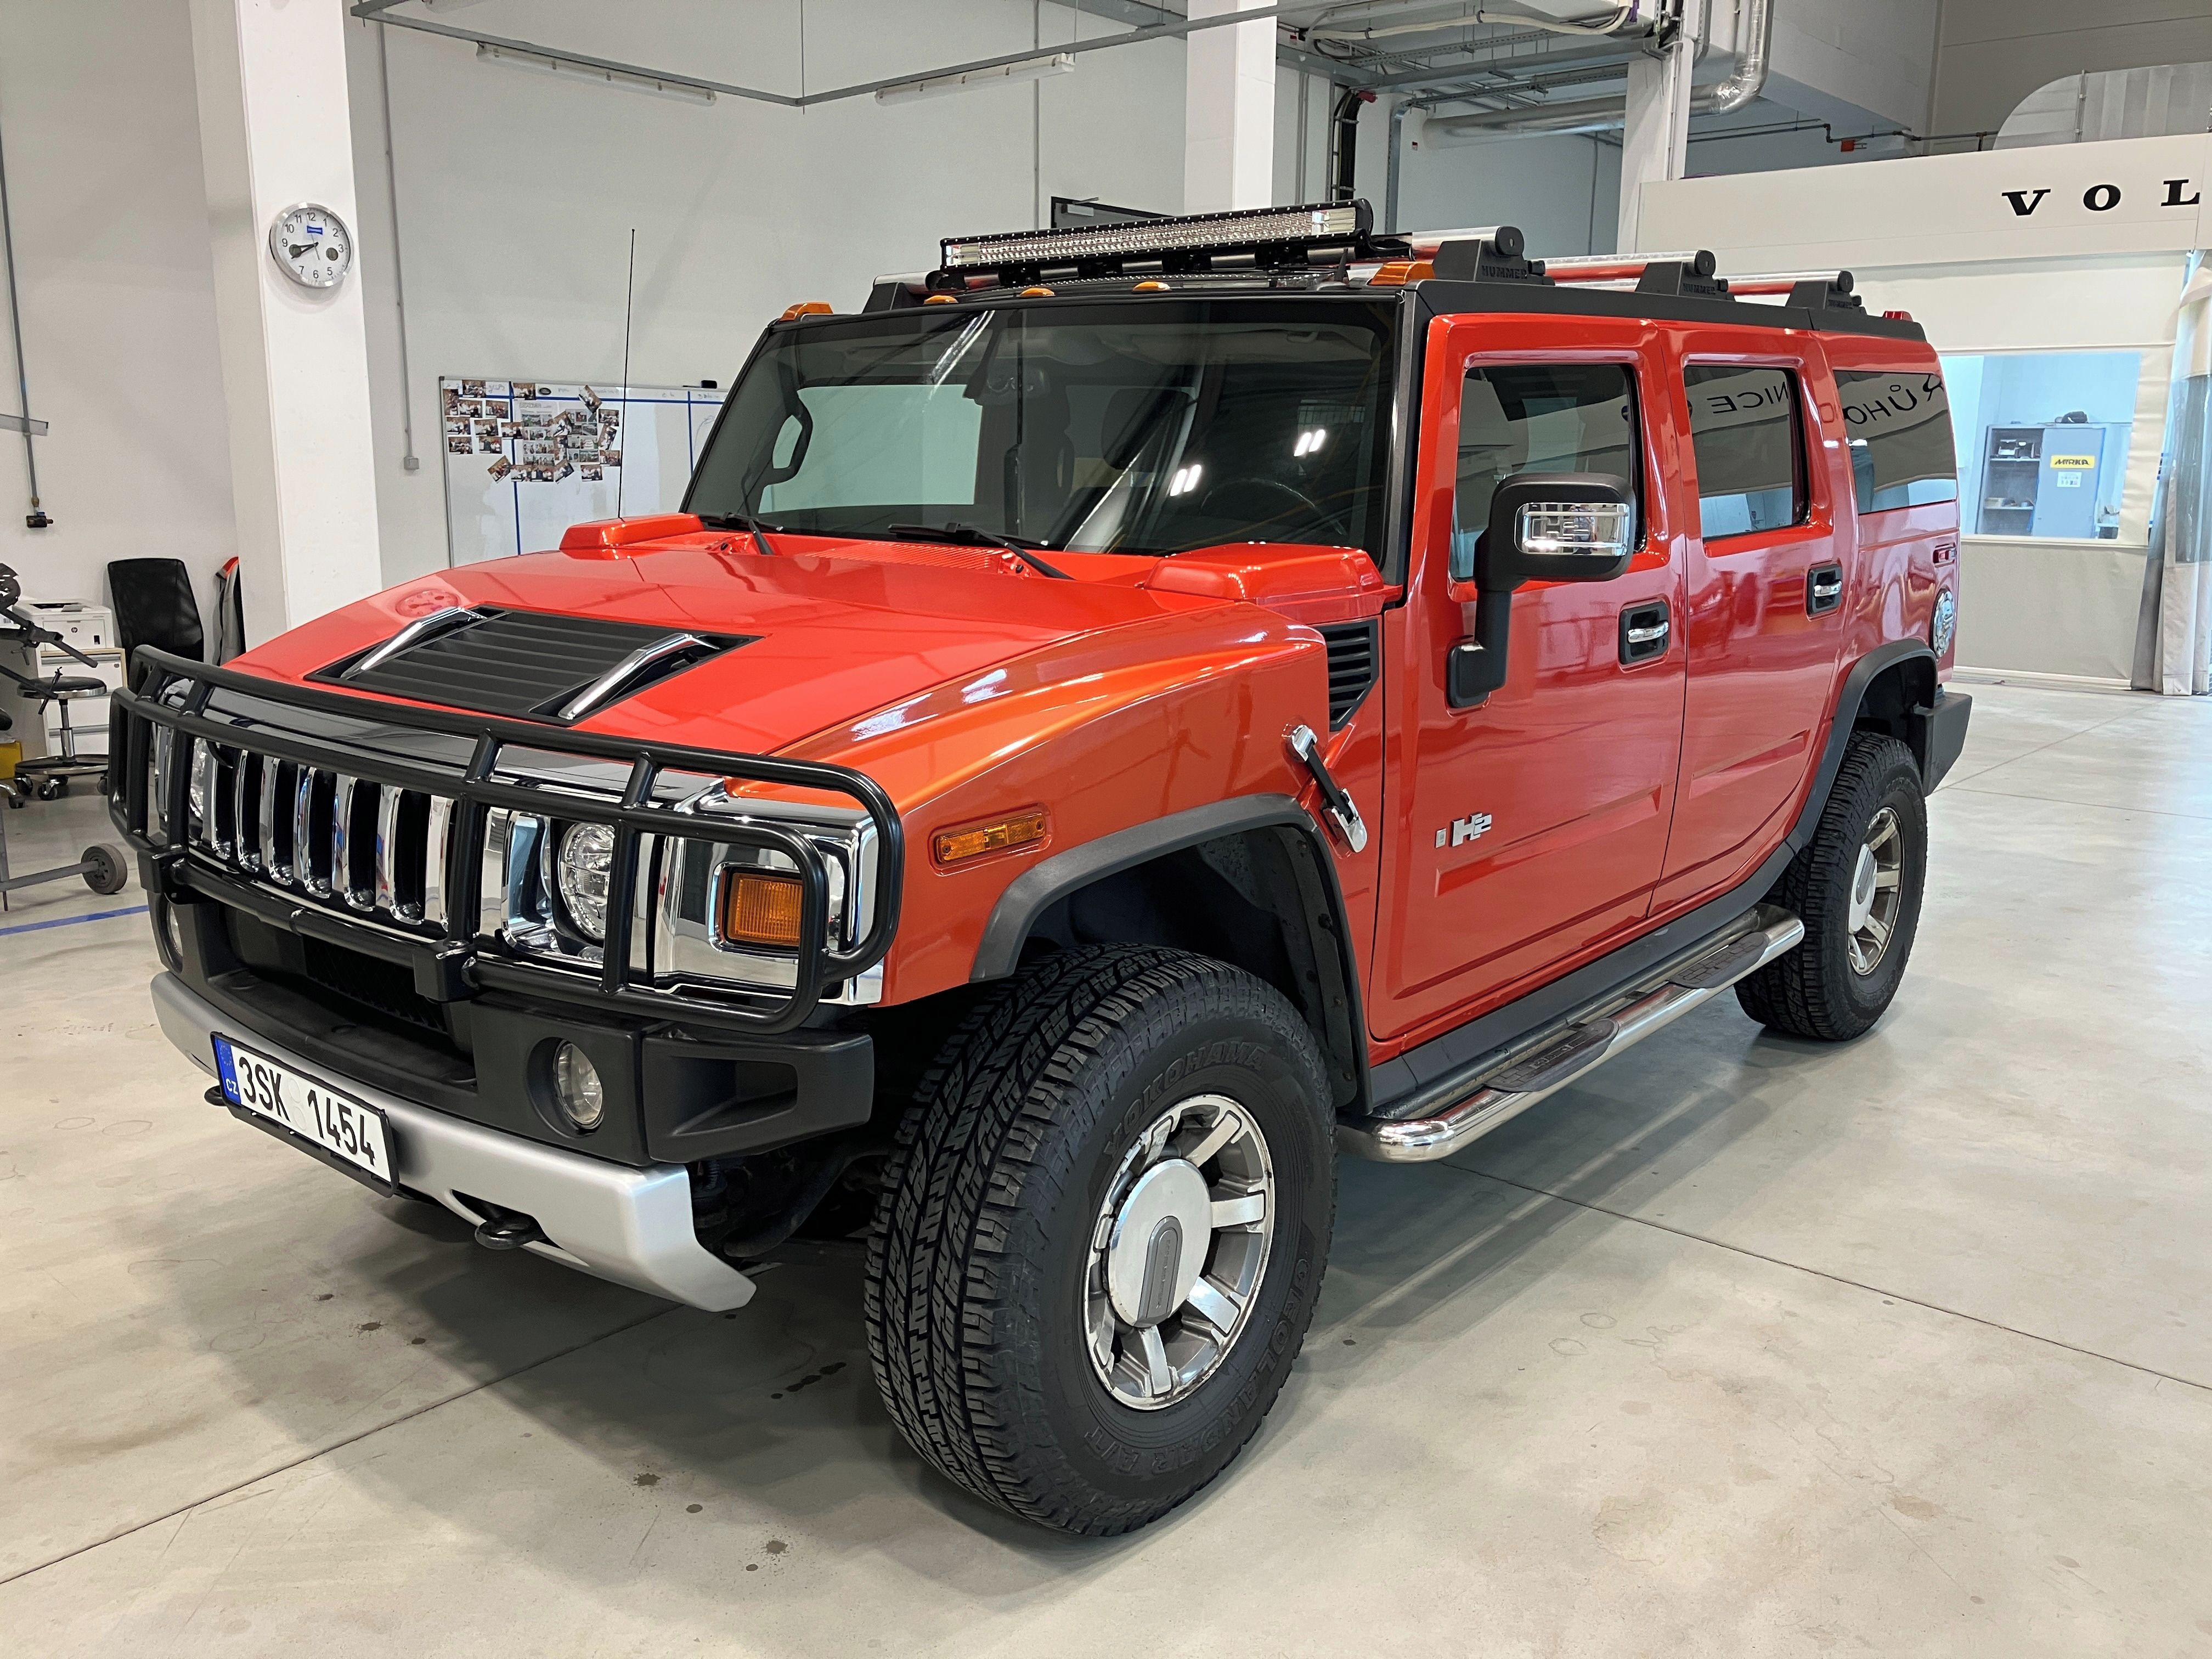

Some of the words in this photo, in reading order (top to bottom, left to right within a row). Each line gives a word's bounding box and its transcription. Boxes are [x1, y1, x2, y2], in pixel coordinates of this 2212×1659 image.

[2001, 179, 2200, 216] VOL
[295, 215, 302, 224] 11
[307, 212, 316, 222] 12
[323, 218, 327, 227] 1
[285, 224, 295, 233] 10
[332, 228, 338, 238] 2
[281, 238, 288, 247] 9
[338, 244, 344, 253] 3
[298, 266, 304, 275] 7
[313, 270, 319, 279] 6
[327, 267, 333, 275] 5
[1481, 265, 1528, 279] HUMMER
[1450, 812, 1492, 847] H2
[225, 1078, 239, 1095] CZ
[239, 1056, 291, 1123] 3SK
[307, 1089, 376, 1167] 1454
